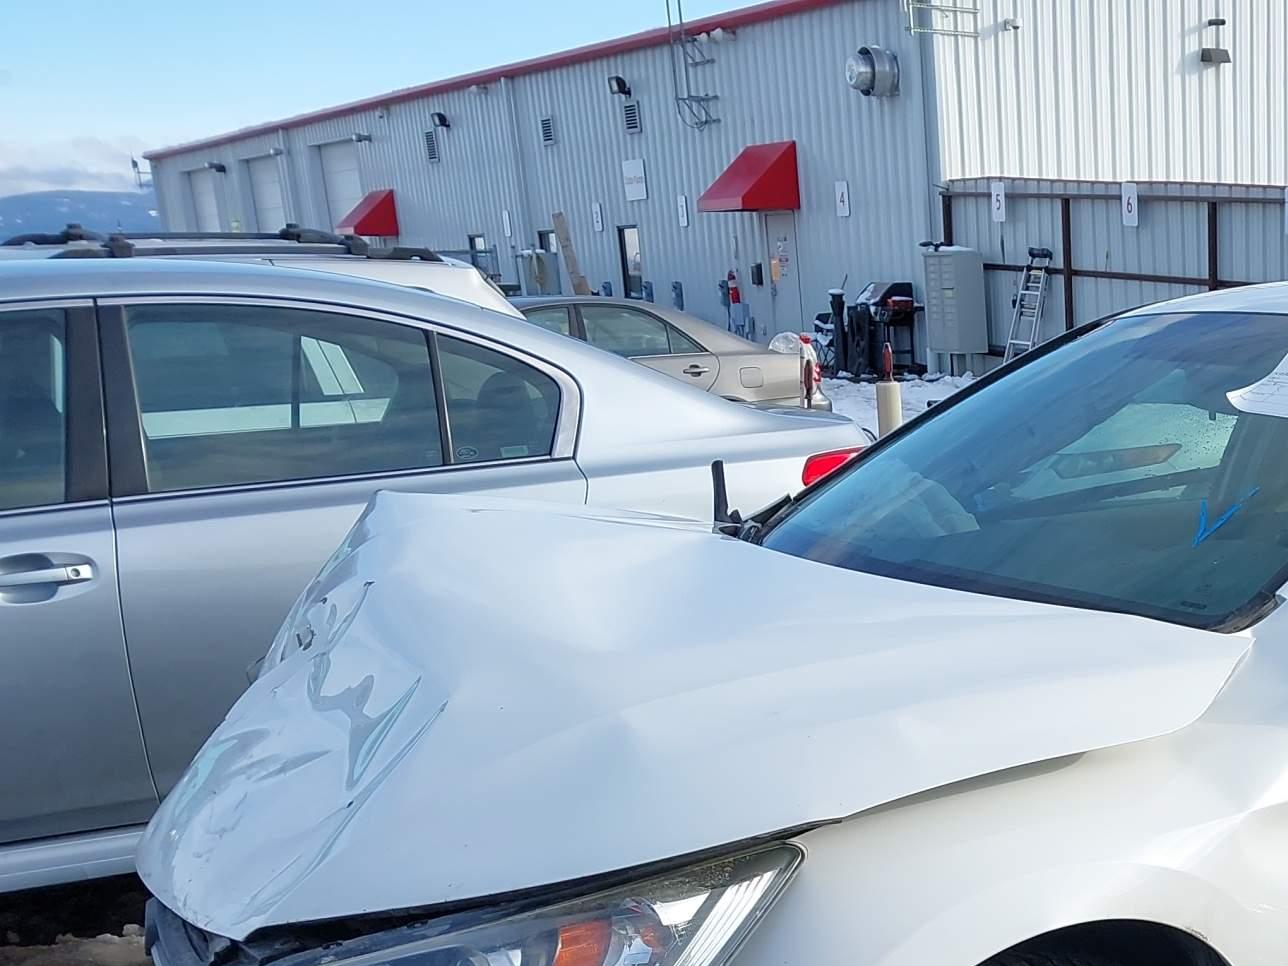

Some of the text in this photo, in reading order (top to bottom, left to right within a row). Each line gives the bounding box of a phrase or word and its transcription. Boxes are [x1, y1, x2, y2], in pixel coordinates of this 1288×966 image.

[839, 192, 845, 206] 4
[995, 193, 1002, 210] 5
[1126, 196, 1133, 214] 6
